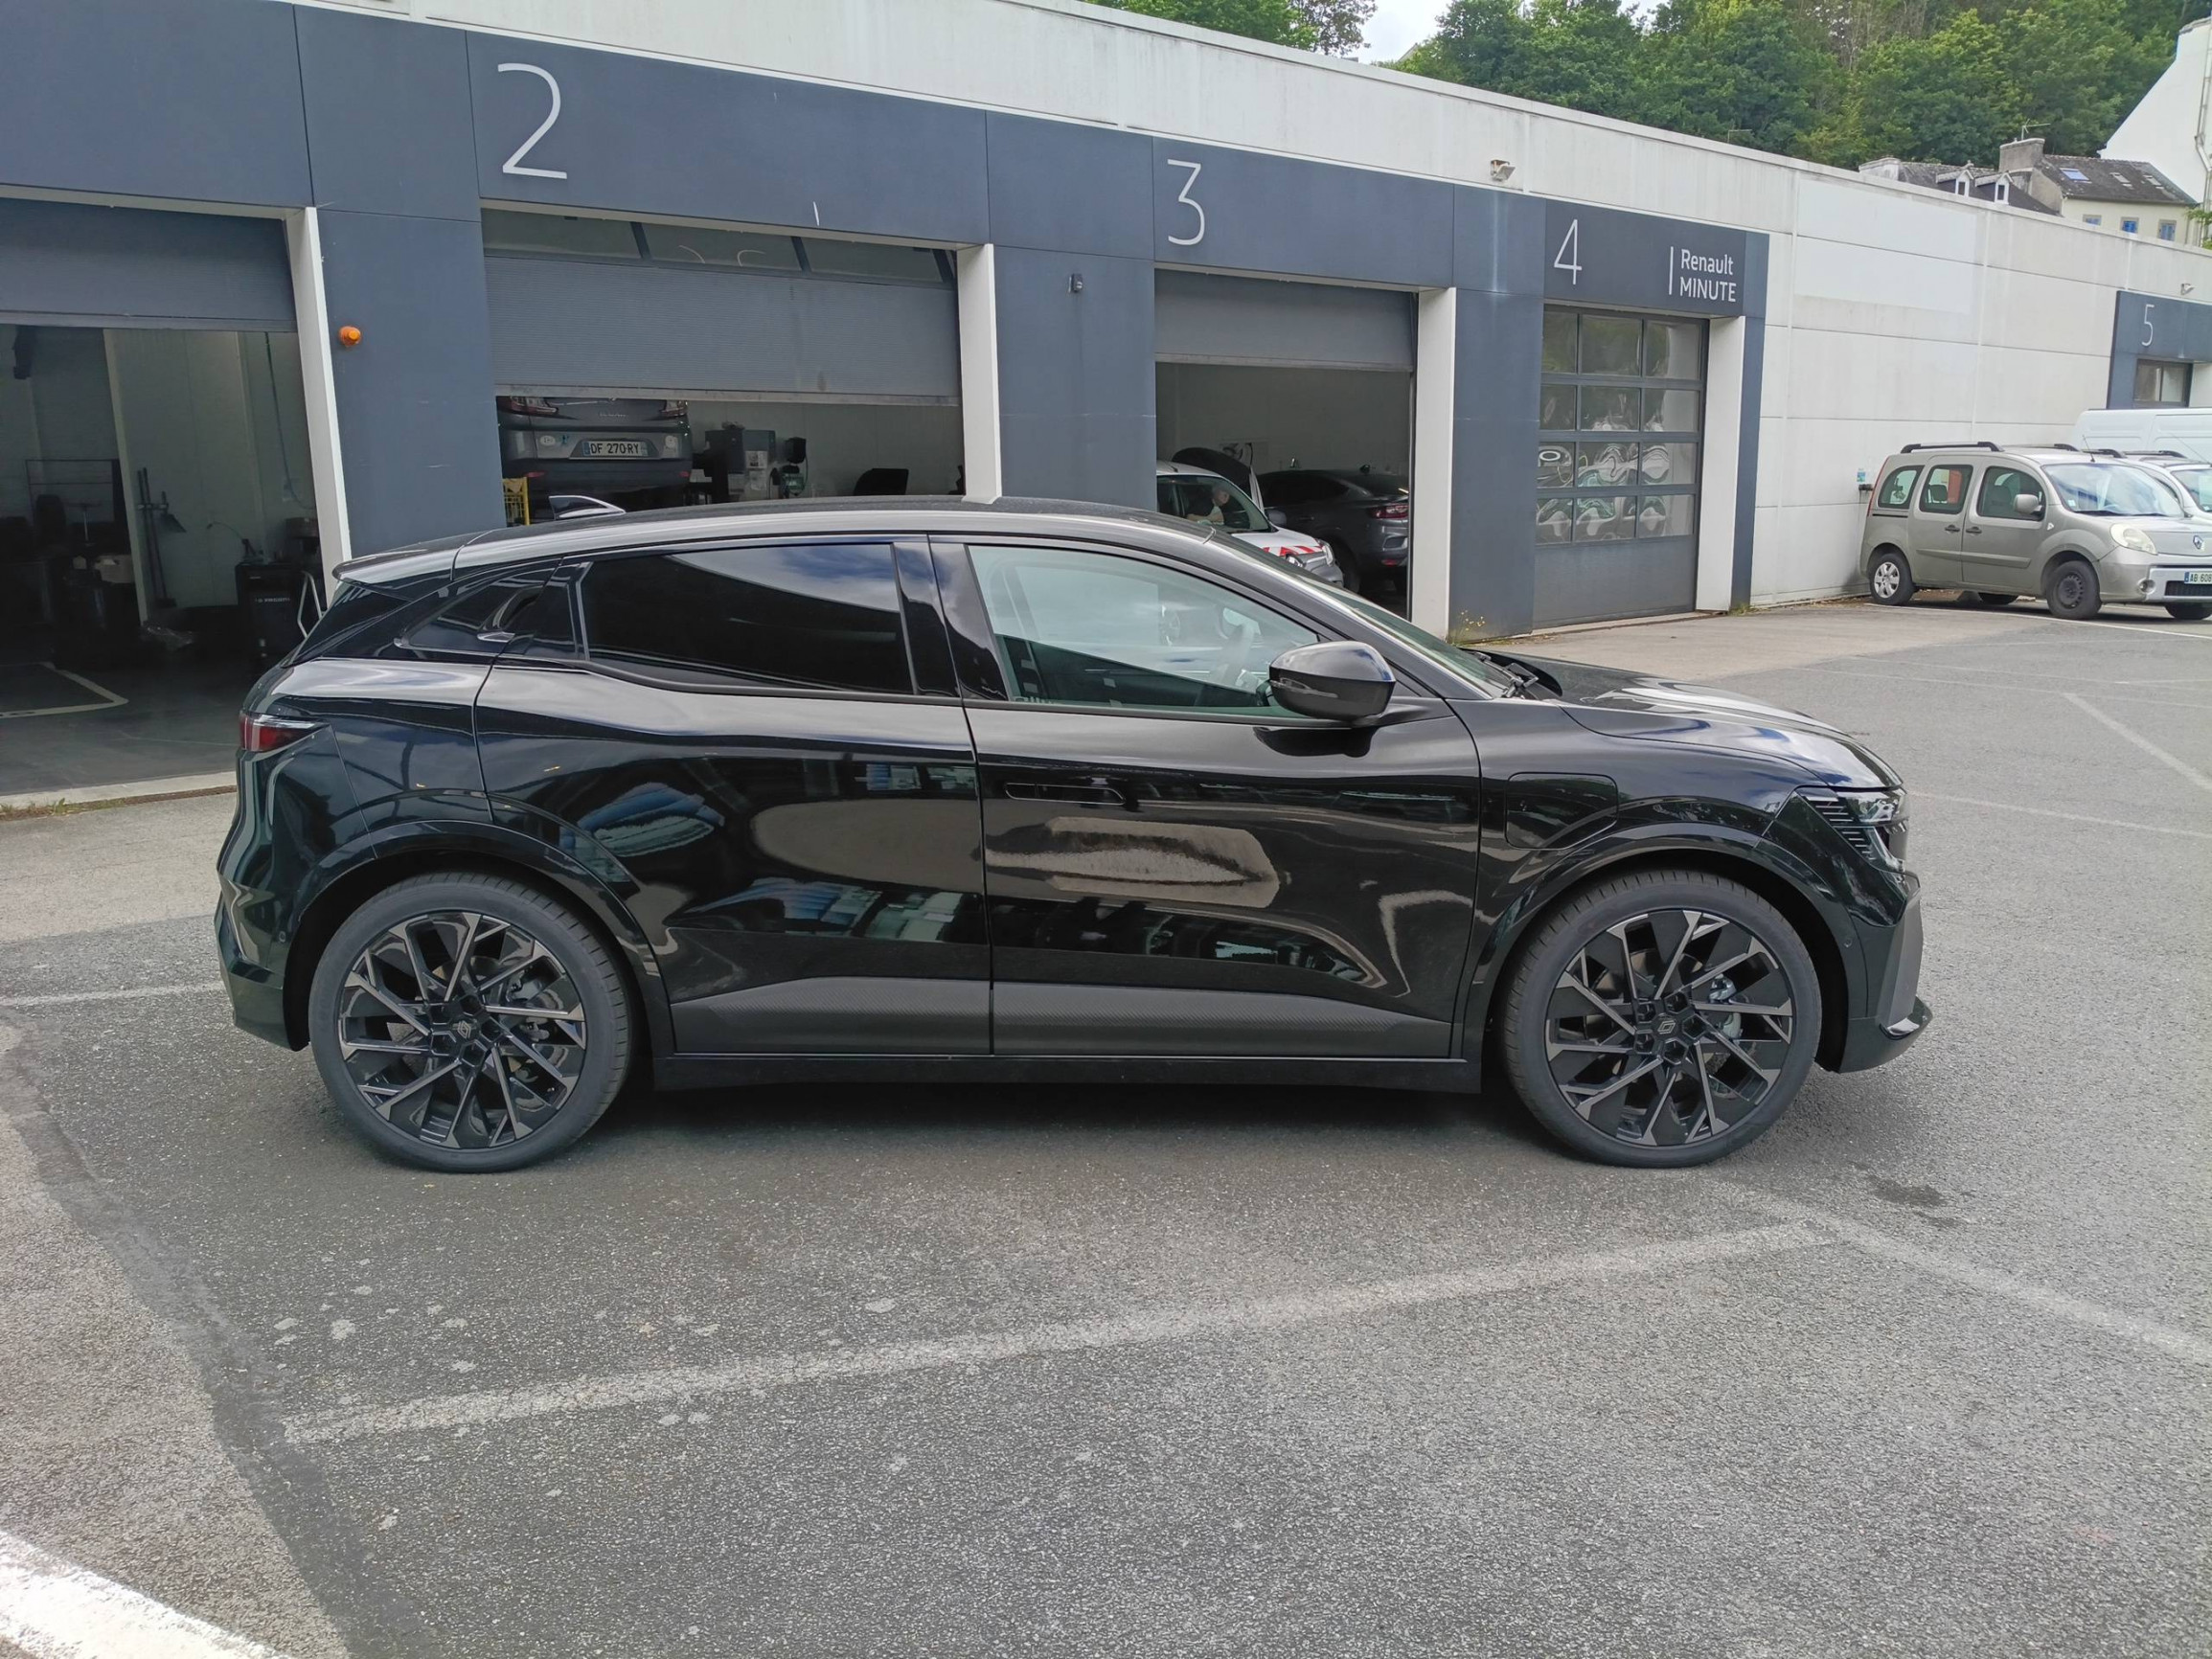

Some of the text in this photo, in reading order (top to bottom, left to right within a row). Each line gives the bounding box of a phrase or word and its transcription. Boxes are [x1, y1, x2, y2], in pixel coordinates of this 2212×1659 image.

[498, 63, 567, 179] 2
[1168, 159, 1205, 245] 3
[1554, 219, 1582, 284] 4
[1680, 249, 1733, 275] Renault
[1679, 277, 1736, 302] MINUTE
[2142, 304, 2155, 346] 5
